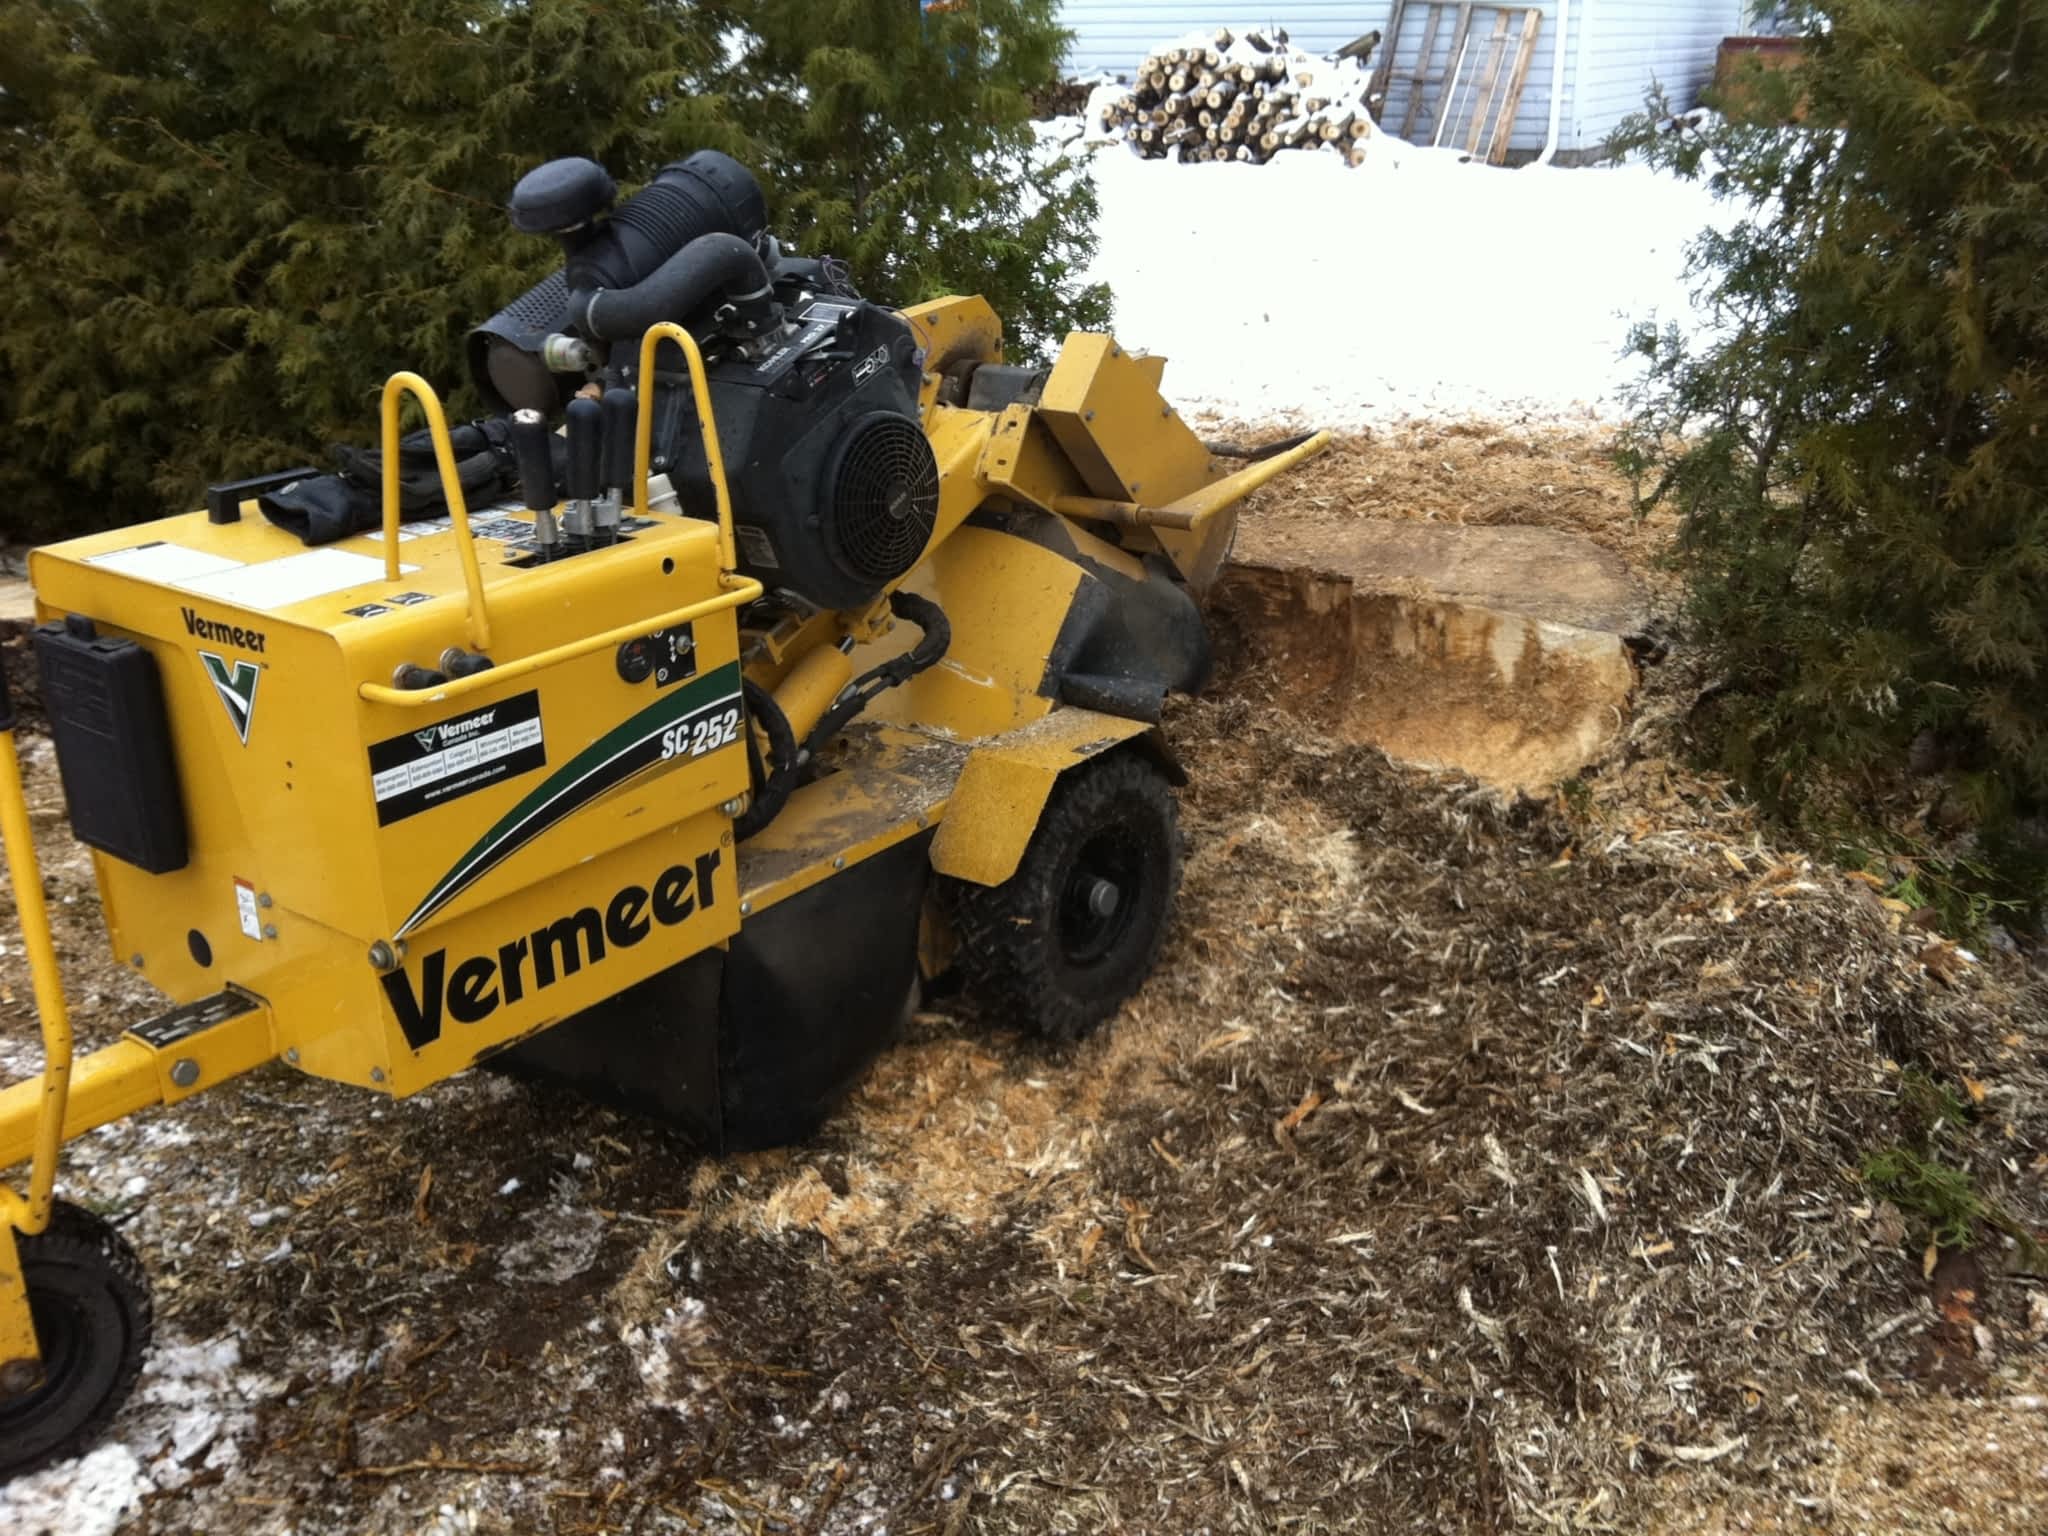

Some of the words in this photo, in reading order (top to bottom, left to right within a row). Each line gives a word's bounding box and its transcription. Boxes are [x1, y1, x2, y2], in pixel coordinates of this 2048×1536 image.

[180, 606, 266, 653] Vermeer
[438, 710, 496, 740] Vermeer
[661, 723, 690, 760] SC
[691, 708, 739, 757] 252
[379, 847, 721, 1051] Vermeer
